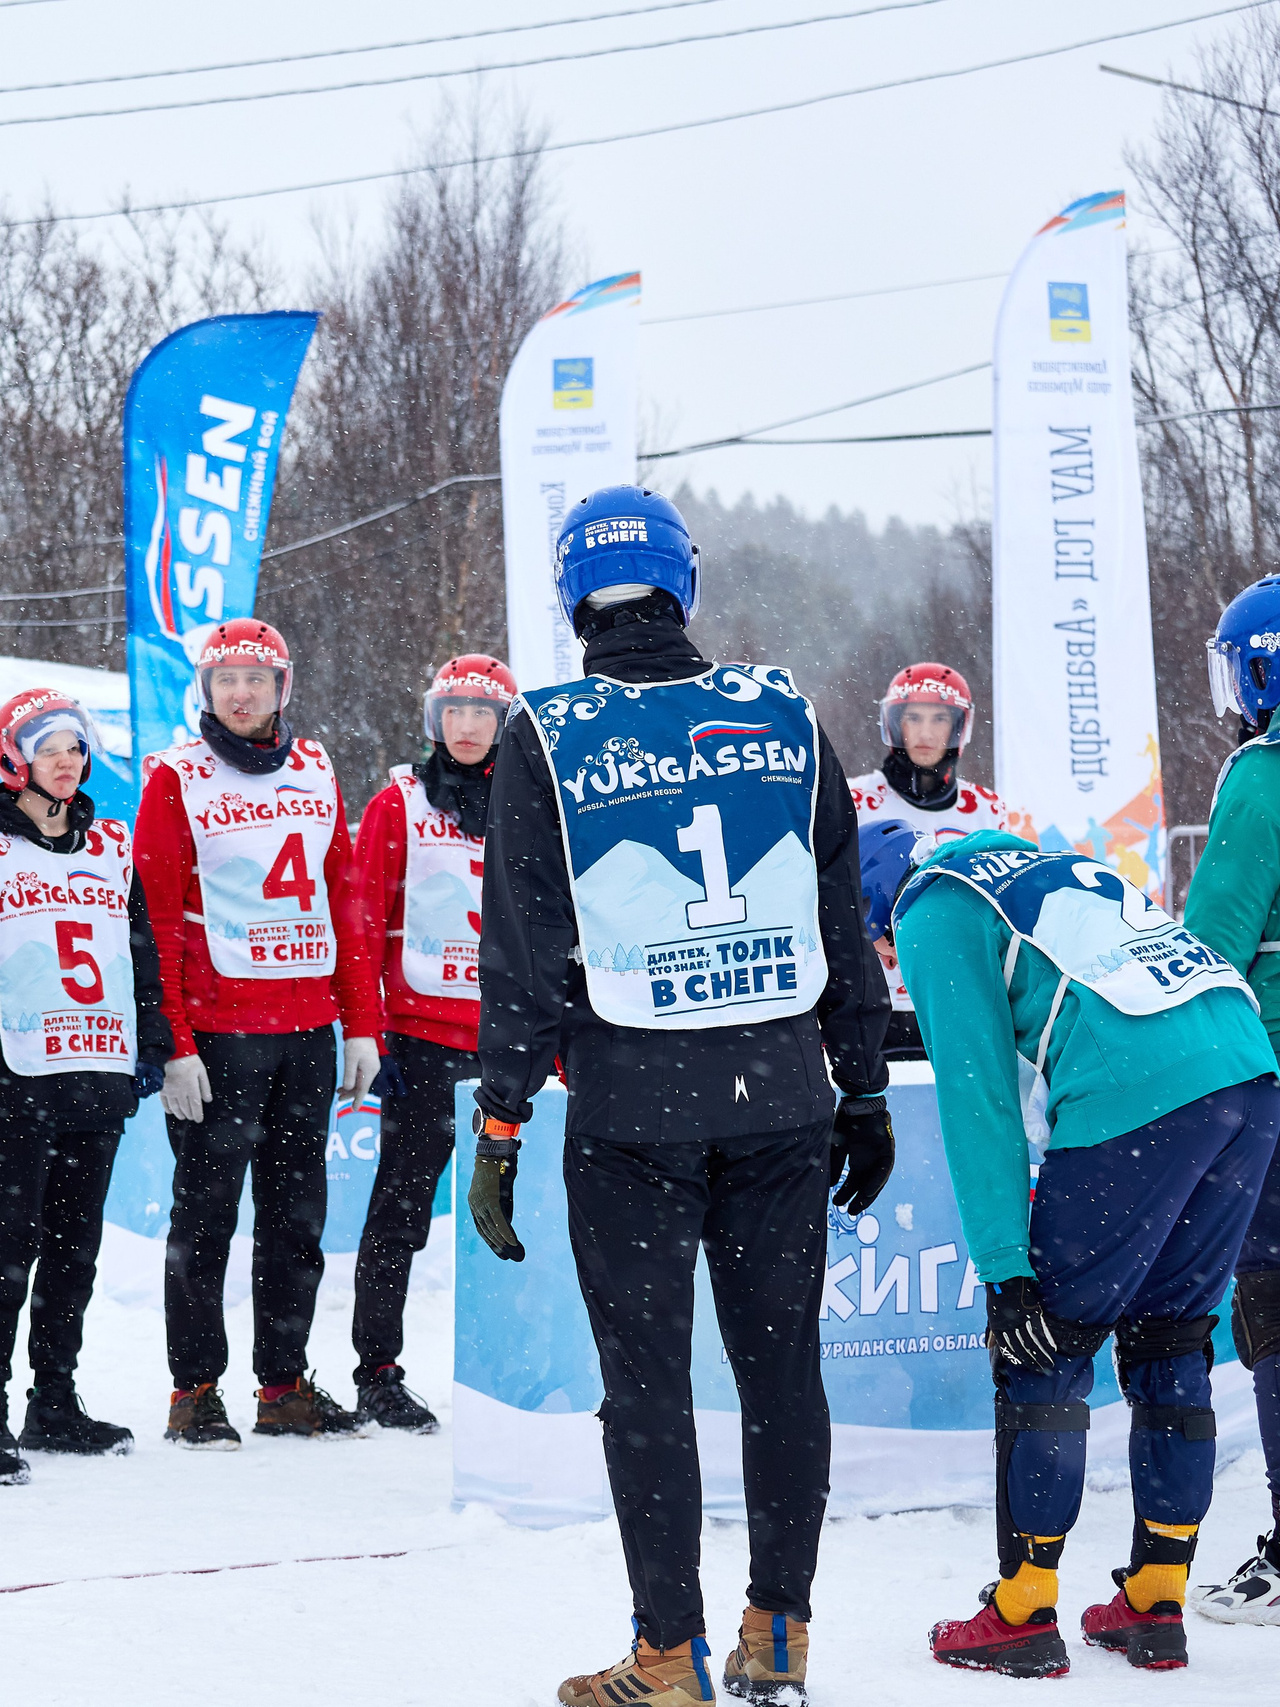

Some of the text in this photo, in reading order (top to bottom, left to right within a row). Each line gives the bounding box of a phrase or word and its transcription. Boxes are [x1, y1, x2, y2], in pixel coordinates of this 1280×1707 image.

[257, 409, 280, 449] БОЙ
[610, 520, 646, 530] ТОЛК
[585, 530, 648, 549] В СНЕГЕ
[608, 790, 653, 806] MURMANSK
[654, 787, 683, 796] REGION
[262, 832, 315, 912] 4
[677, 804, 747, 930] 1
[1071, 862, 1174, 932] 2
[250, 946, 267, 962] В
[647, 935, 795, 966] ДЛЯ ТЕХ, ТОЛК
[1129, 945, 1150, 957] ДЛЯ
[55, 920, 104, 1005] 5
[443, 964, 458, 981] В
[648, 960, 711, 976] КТО ЗНАЕТ
[651, 963, 797, 1008] В СНЕГЕ
[1146, 966, 1170, 986] В
[45, 1036, 62, 1055] В
[820, 1336, 929, 1359] УРМАНСКАЯ
